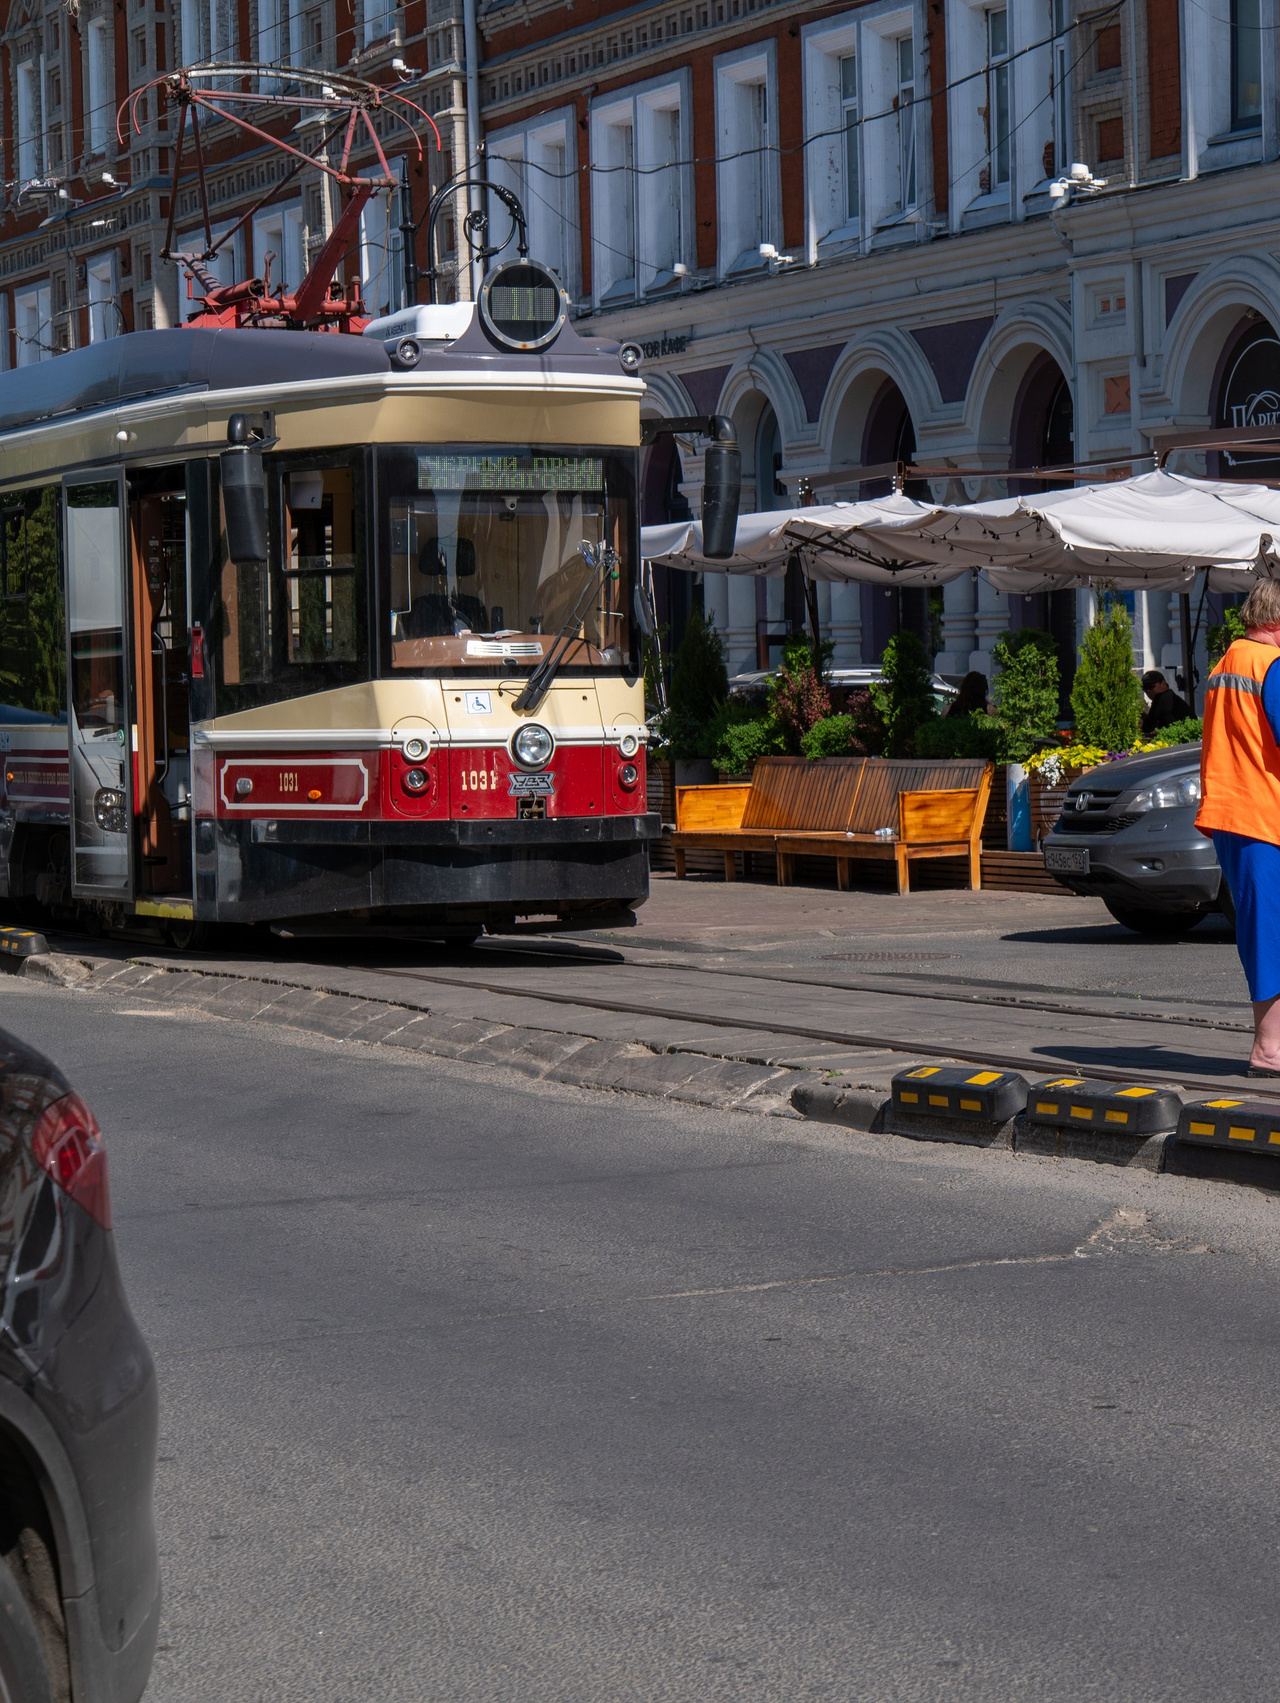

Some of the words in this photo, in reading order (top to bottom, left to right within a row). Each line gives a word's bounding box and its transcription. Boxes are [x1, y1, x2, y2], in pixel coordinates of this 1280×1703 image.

[511, 287, 535, 320] 11
[279, 772, 299, 792] 1031
[461, 770, 497, 791] 1031
